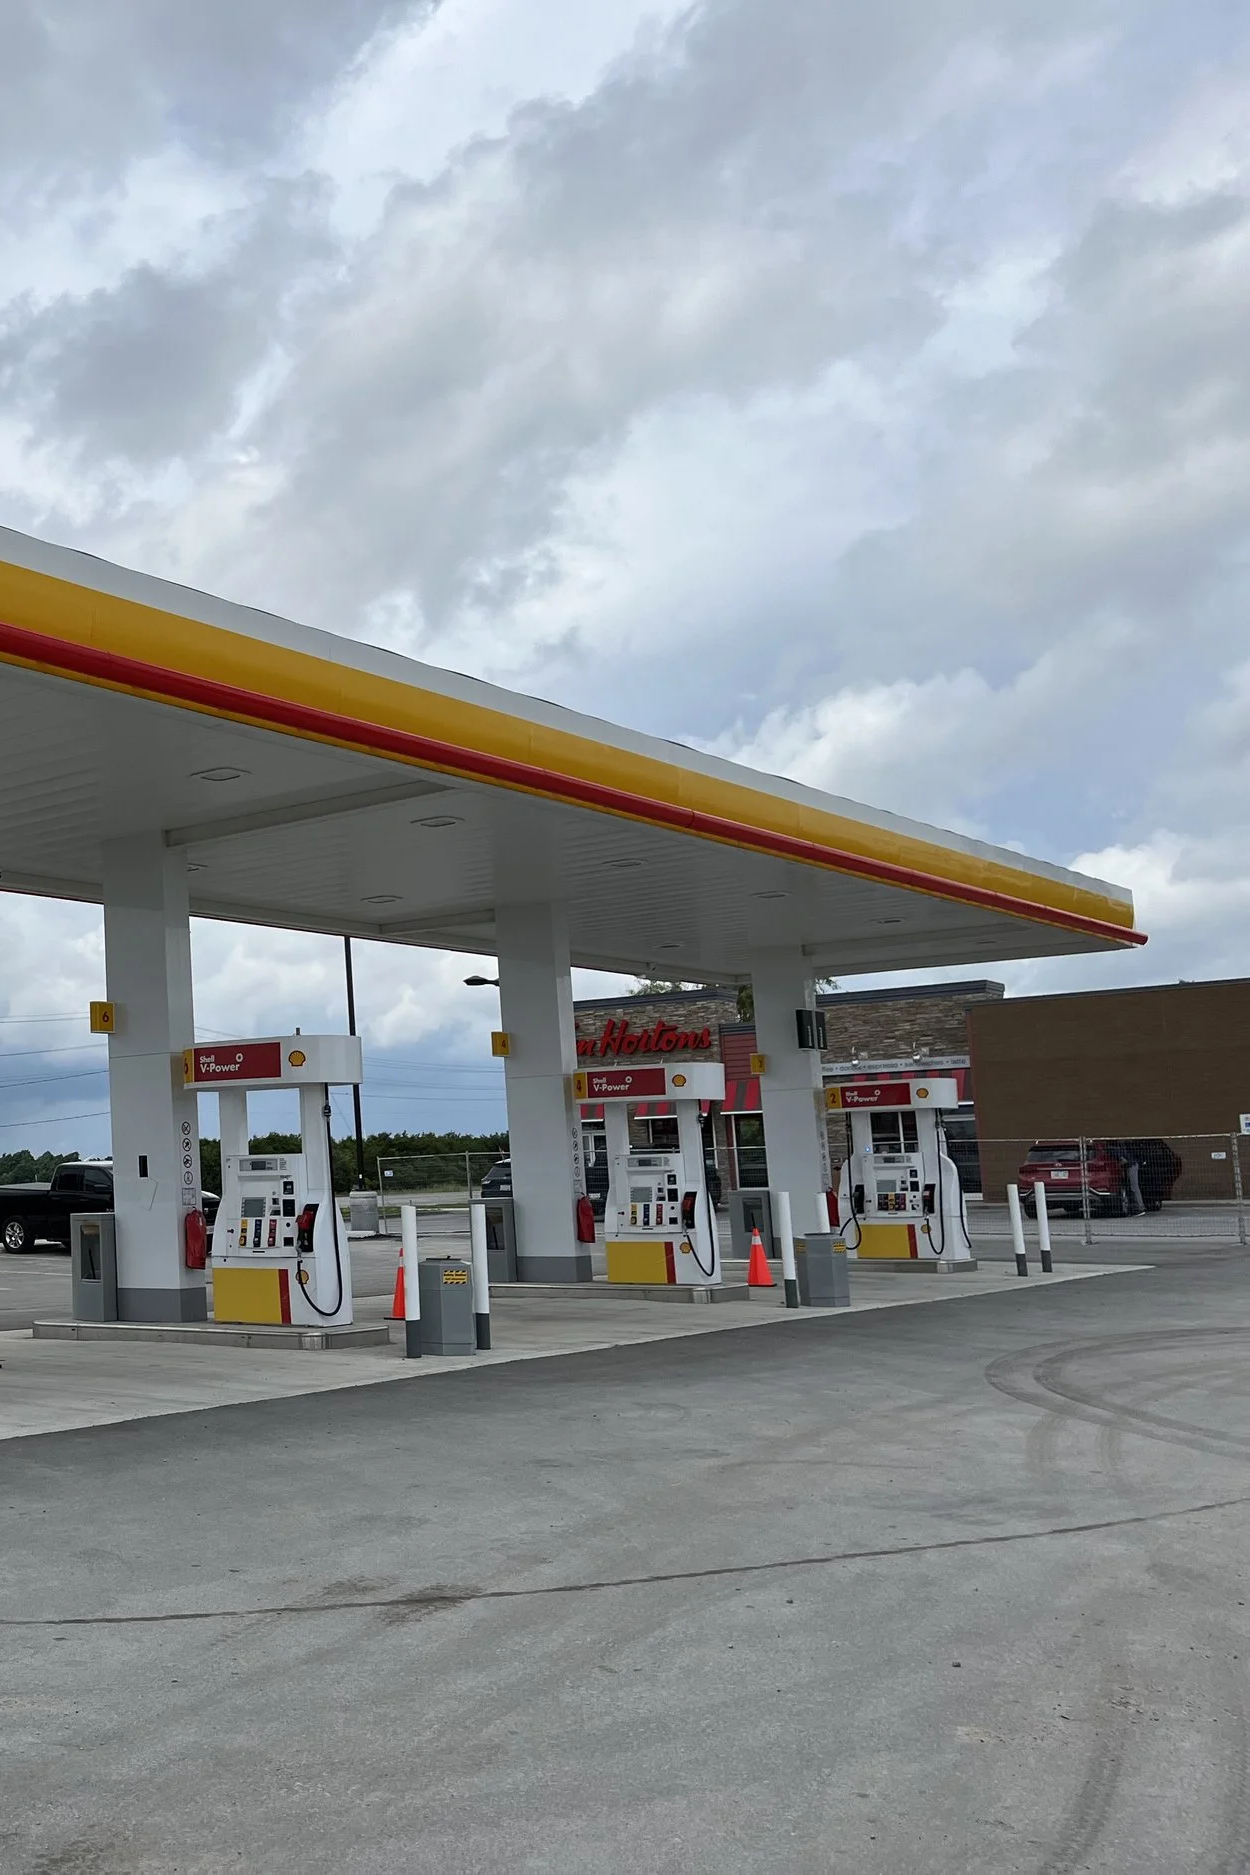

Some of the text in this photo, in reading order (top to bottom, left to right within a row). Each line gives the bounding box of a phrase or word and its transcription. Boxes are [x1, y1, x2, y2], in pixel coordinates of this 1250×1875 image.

[102, 1011, 110, 1023] 6
[600, 1018, 712, 1057] Hortons
[199, 1055, 215, 1063] Shell
[199, 1063, 240, 1073] V-Power
[593, 1083, 630, 1092] V-Power
[830, 1092, 837, 1104] 2
